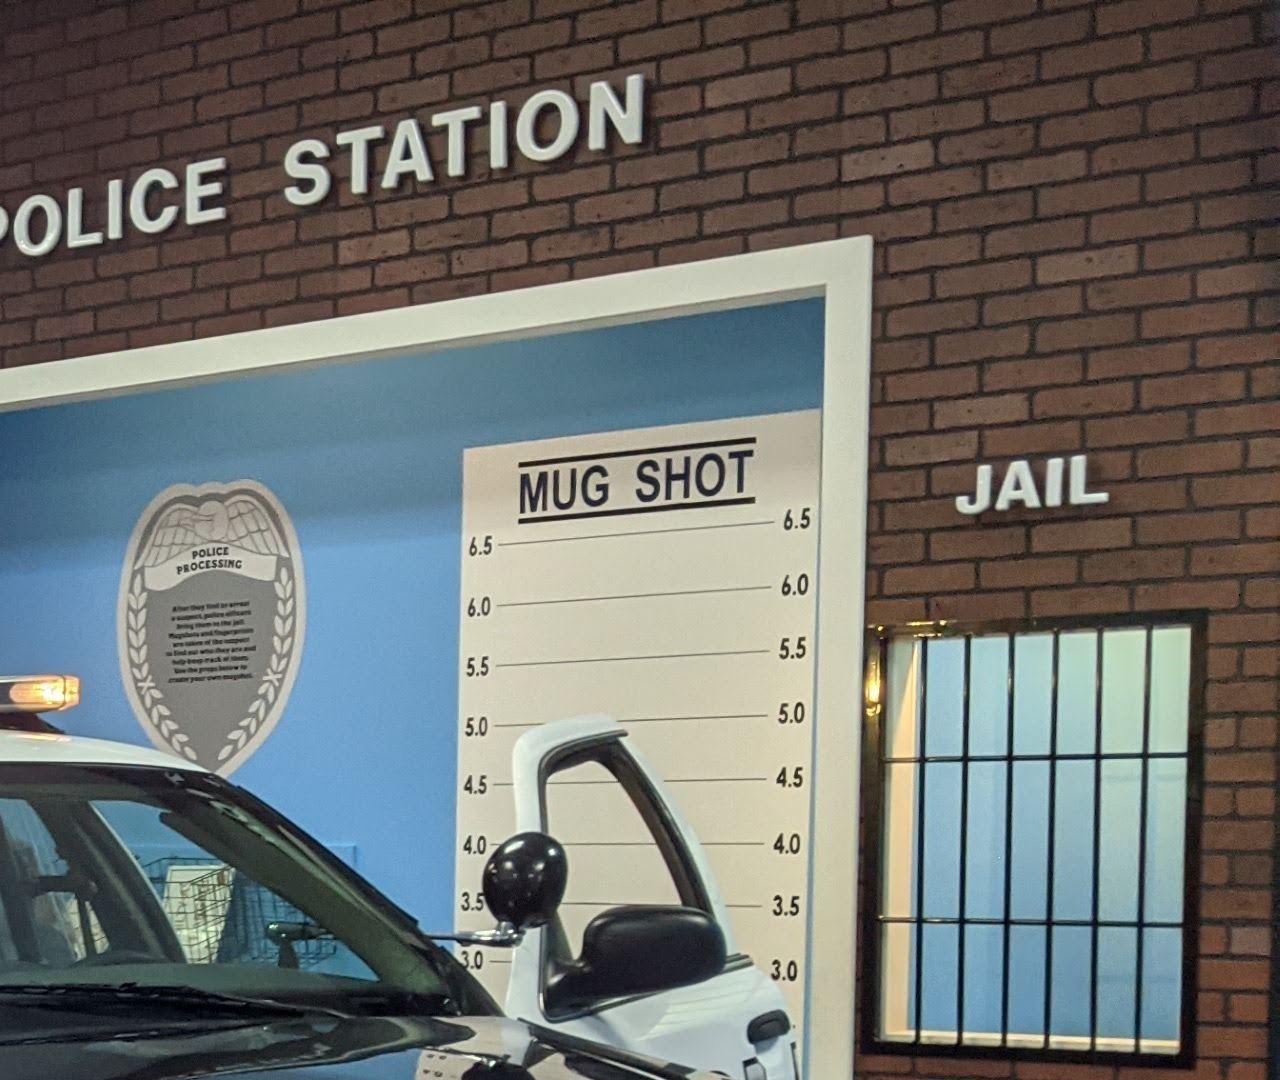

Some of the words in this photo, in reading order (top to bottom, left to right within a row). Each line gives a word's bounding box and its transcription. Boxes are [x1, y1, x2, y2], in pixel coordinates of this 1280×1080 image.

[284, 73, 644, 206] STATION
[518, 465, 610, 515] MUG
[635, 449, 755, 504] SHOT
[955, 454, 1110, 515] JAIL
[469, 535, 493, 557] 6.5
[783, 507, 811, 531] 6.5
[176, 559, 242, 575] PROCESSING
[192, 546, 230, 560] POLICE
[467, 596, 491, 618] 6.0
[781, 573, 809, 597] 6.0
[466, 656, 489, 677] 5.5
[778, 636, 806, 660] 5.5
[465, 717, 488, 737] 5.0
[778, 702, 805, 725] 5.0
[463, 775, 487, 795] 4.5
[776, 766, 803, 788] 4.5
[463, 835, 487, 855] 4.0
[773, 833, 801, 855] 4.0
[461, 891, 484, 912] 3.5
[772, 894, 800, 917] 3.5
[461, 950, 483, 970] 3.0
[770, 959, 798, 982] 3.0
